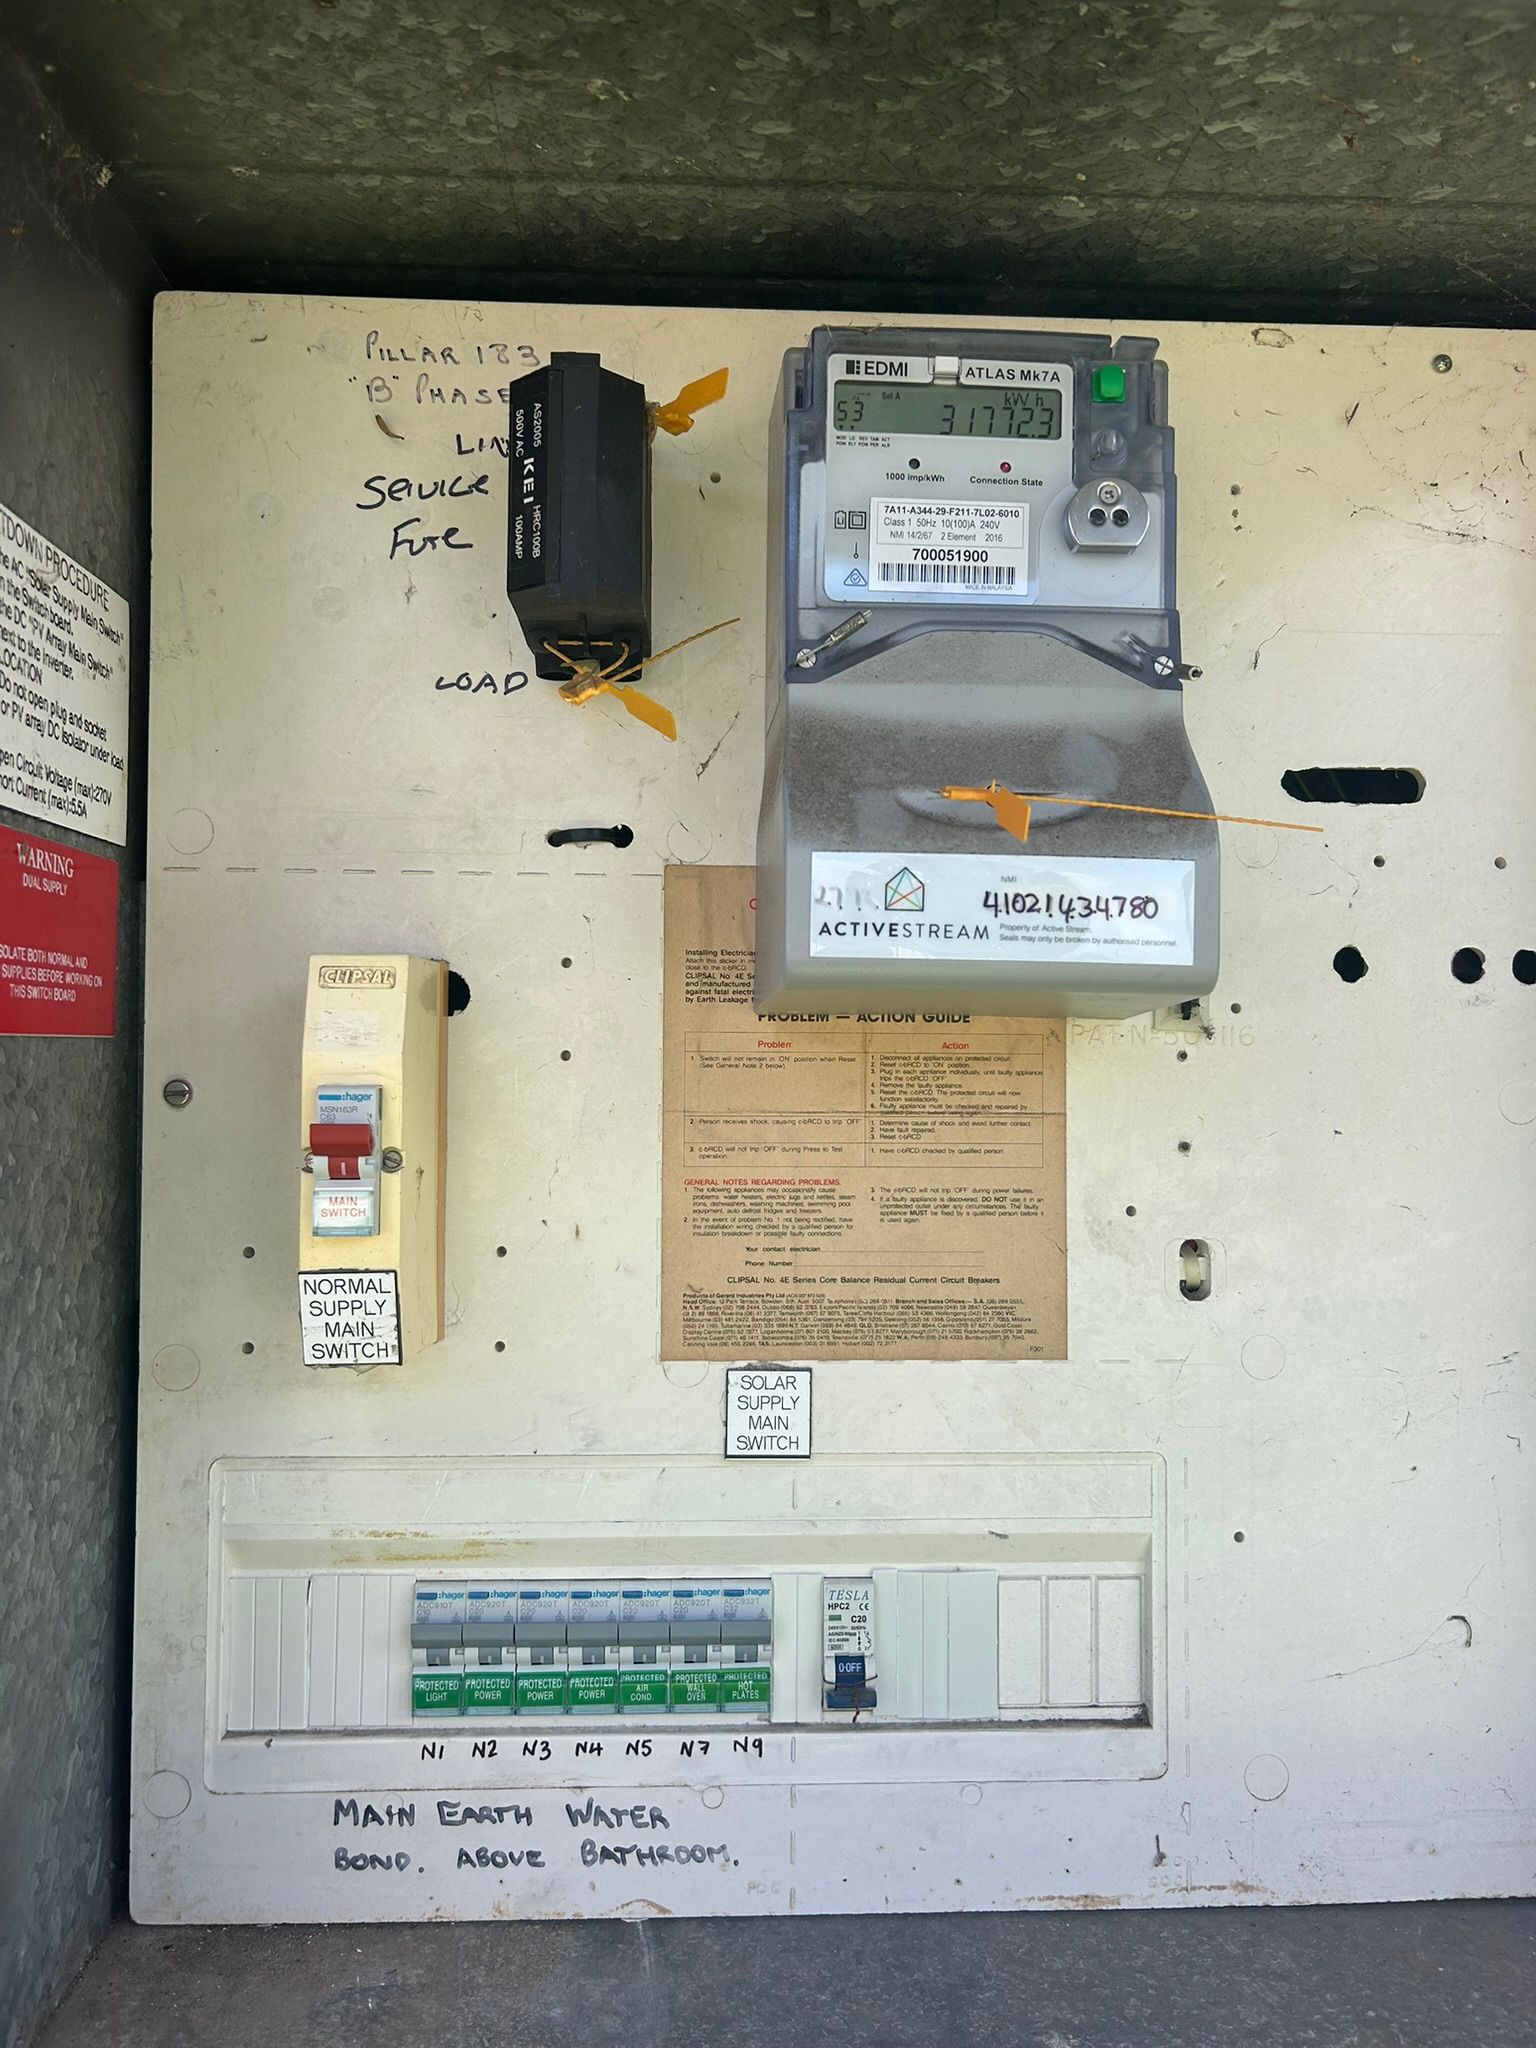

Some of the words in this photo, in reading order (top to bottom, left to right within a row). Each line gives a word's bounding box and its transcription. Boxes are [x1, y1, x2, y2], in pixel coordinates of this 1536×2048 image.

[864, 360, 908, 377] EDMI
[965, 367, 1016, 380] ATLAS
[1020, 370, 1060, 382] Mk7A
[881, 391, 894, 400] Set
[516, 409, 524, 438] 500V
[533, 402, 542, 448] AS2005
[516, 440, 524, 458] AC
[523, 457, 535, 504] KEI
[885, 472, 906, 481] 1000
[907, 473, 945, 482] imp/kWh
[969, 476, 1019, 485] Connection
[1021, 478, 1043, 487] State
[883, 517, 906, 527] Class
[916, 518, 937, 528] 50Hz
[941, 519, 976, 531] 10(100)A
[980, 520, 1001, 530] 240V
[514, 514, 524, 559] 100AMP
[532, 504, 542, 559] HRC100B
[890, 530, 904, 539] NMI
[947, 532, 976, 542] Element
[985, 533, 1003, 542] 2016
[912, 548, 989, 563] 700051900
[46, 545, 110, 612] PROCEDURE
[17, 842, 74, 878] WARNING
[23, 873, 42, 890] DUAL
[43, 880, 68, 896] SUPPLY
[1000, 924, 1030, 933] Property
[1042, 924, 1064, 933] Active
[1000, 934, 1019, 942] Seals
[1021, 936, 1036, 944] may
[1038, 935, 1052, 945] only
[1054, 935, 1064, 943] be
[1066, 936, 1090, 944] broken
[1092, 937, 1100, 946] by
[27, 948, 46, 964] BOTH
[48, 952, 74, 968] NORMAL
[76, 957, 88, 969] AND
[2, 964, 36, 981] SUPPLIES
[38, 968, 64, 984] BEFORE
[66, 974, 93, 987] WORKING
[94, 976, 102, 987] ON
[324, 968, 392, 985] CLIPSAL
[10, 984, 26, 998] THIS
[27, 986, 53, 1000] SWITCH
[54, 988, 76, 1002] BOARD
[942, 1041, 970, 1050] Action
[684, 1178, 719, 1186] GENERAL
[723, 1178, 748, 1186] NOTES
[751, 1178, 795, 1186] REGARDING
[329, 1196, 358, 1206] MAIN
[320, 1208, 367, 1217] SWITCH
[304, 1278, 391, 1295] NORMAL
[726, 1276, 760, 1284] CLIPSAL
[779, 1276, 790, 1284] 4E
[792, 1276, 816, 1284] Series
[820, 1276, 838, 1284] Core
[840, 1276, 870, 1284] Balance
[874, 1276, 906, 1284] Residual
[909, 1276, 938, 1284] Current
[940, 1276, 965, 1284] Circuit
[968, 1276, 1000, 1284] Breakers
[309, 1300, 386, 1317] SUPPLY
[325, 1321, 375, 1338] MAIN
[312, 1342, 389, 1359] SWITCH
[741, 1375, 797, 1390] SOLAR
[737, 1395, 800, 1410] SUPPLY
[749, 1416, 788, 1430] MAIN
[736, 1435, 799, 1451] SWITCH
[828, 1590, 870, 1601] TESLA
[828, 1602, 850, 1611] HPC2
[851, 1615, 867, 1623] C20
[570, 1676, 614, 1688] PROTECTED
[675, 1673, 718, 1682] PROTECTED
[724, 1672, 768, 1680] PROTECTED
[415, 1679, 459, 1691] PROTECTED
[465, 1678, 511, 1689] PROTECTED
[518, 1678, 562, 1689] PROTECTED
[636, 1684, 649, 1692] AIR
[687, 1683, 706, 1692] WALL
[737, 1681, 753, 1690] HOT
[426, 1692, 447, 1702] LIGHT
[474, 1690, 502, 1700] POWER
[527, 1691, 554, 1700] POWER
[579, 1689, 606, 1699] POWER
[686, 1692, 706, 1701] OVEN
[732, 1690, 760, 1700] PLATES
[421, 1742, 445, 1761] N1
[471, 1739, 498, 1758] N2
[522, 1740, 552, 1761] N3
[575, 1741, 603, 1757] N4
[626, 1738, 652, 1757] N5
[680, 1740, 711, 1758] N7
[733, 1736, 763, 1758] N9
